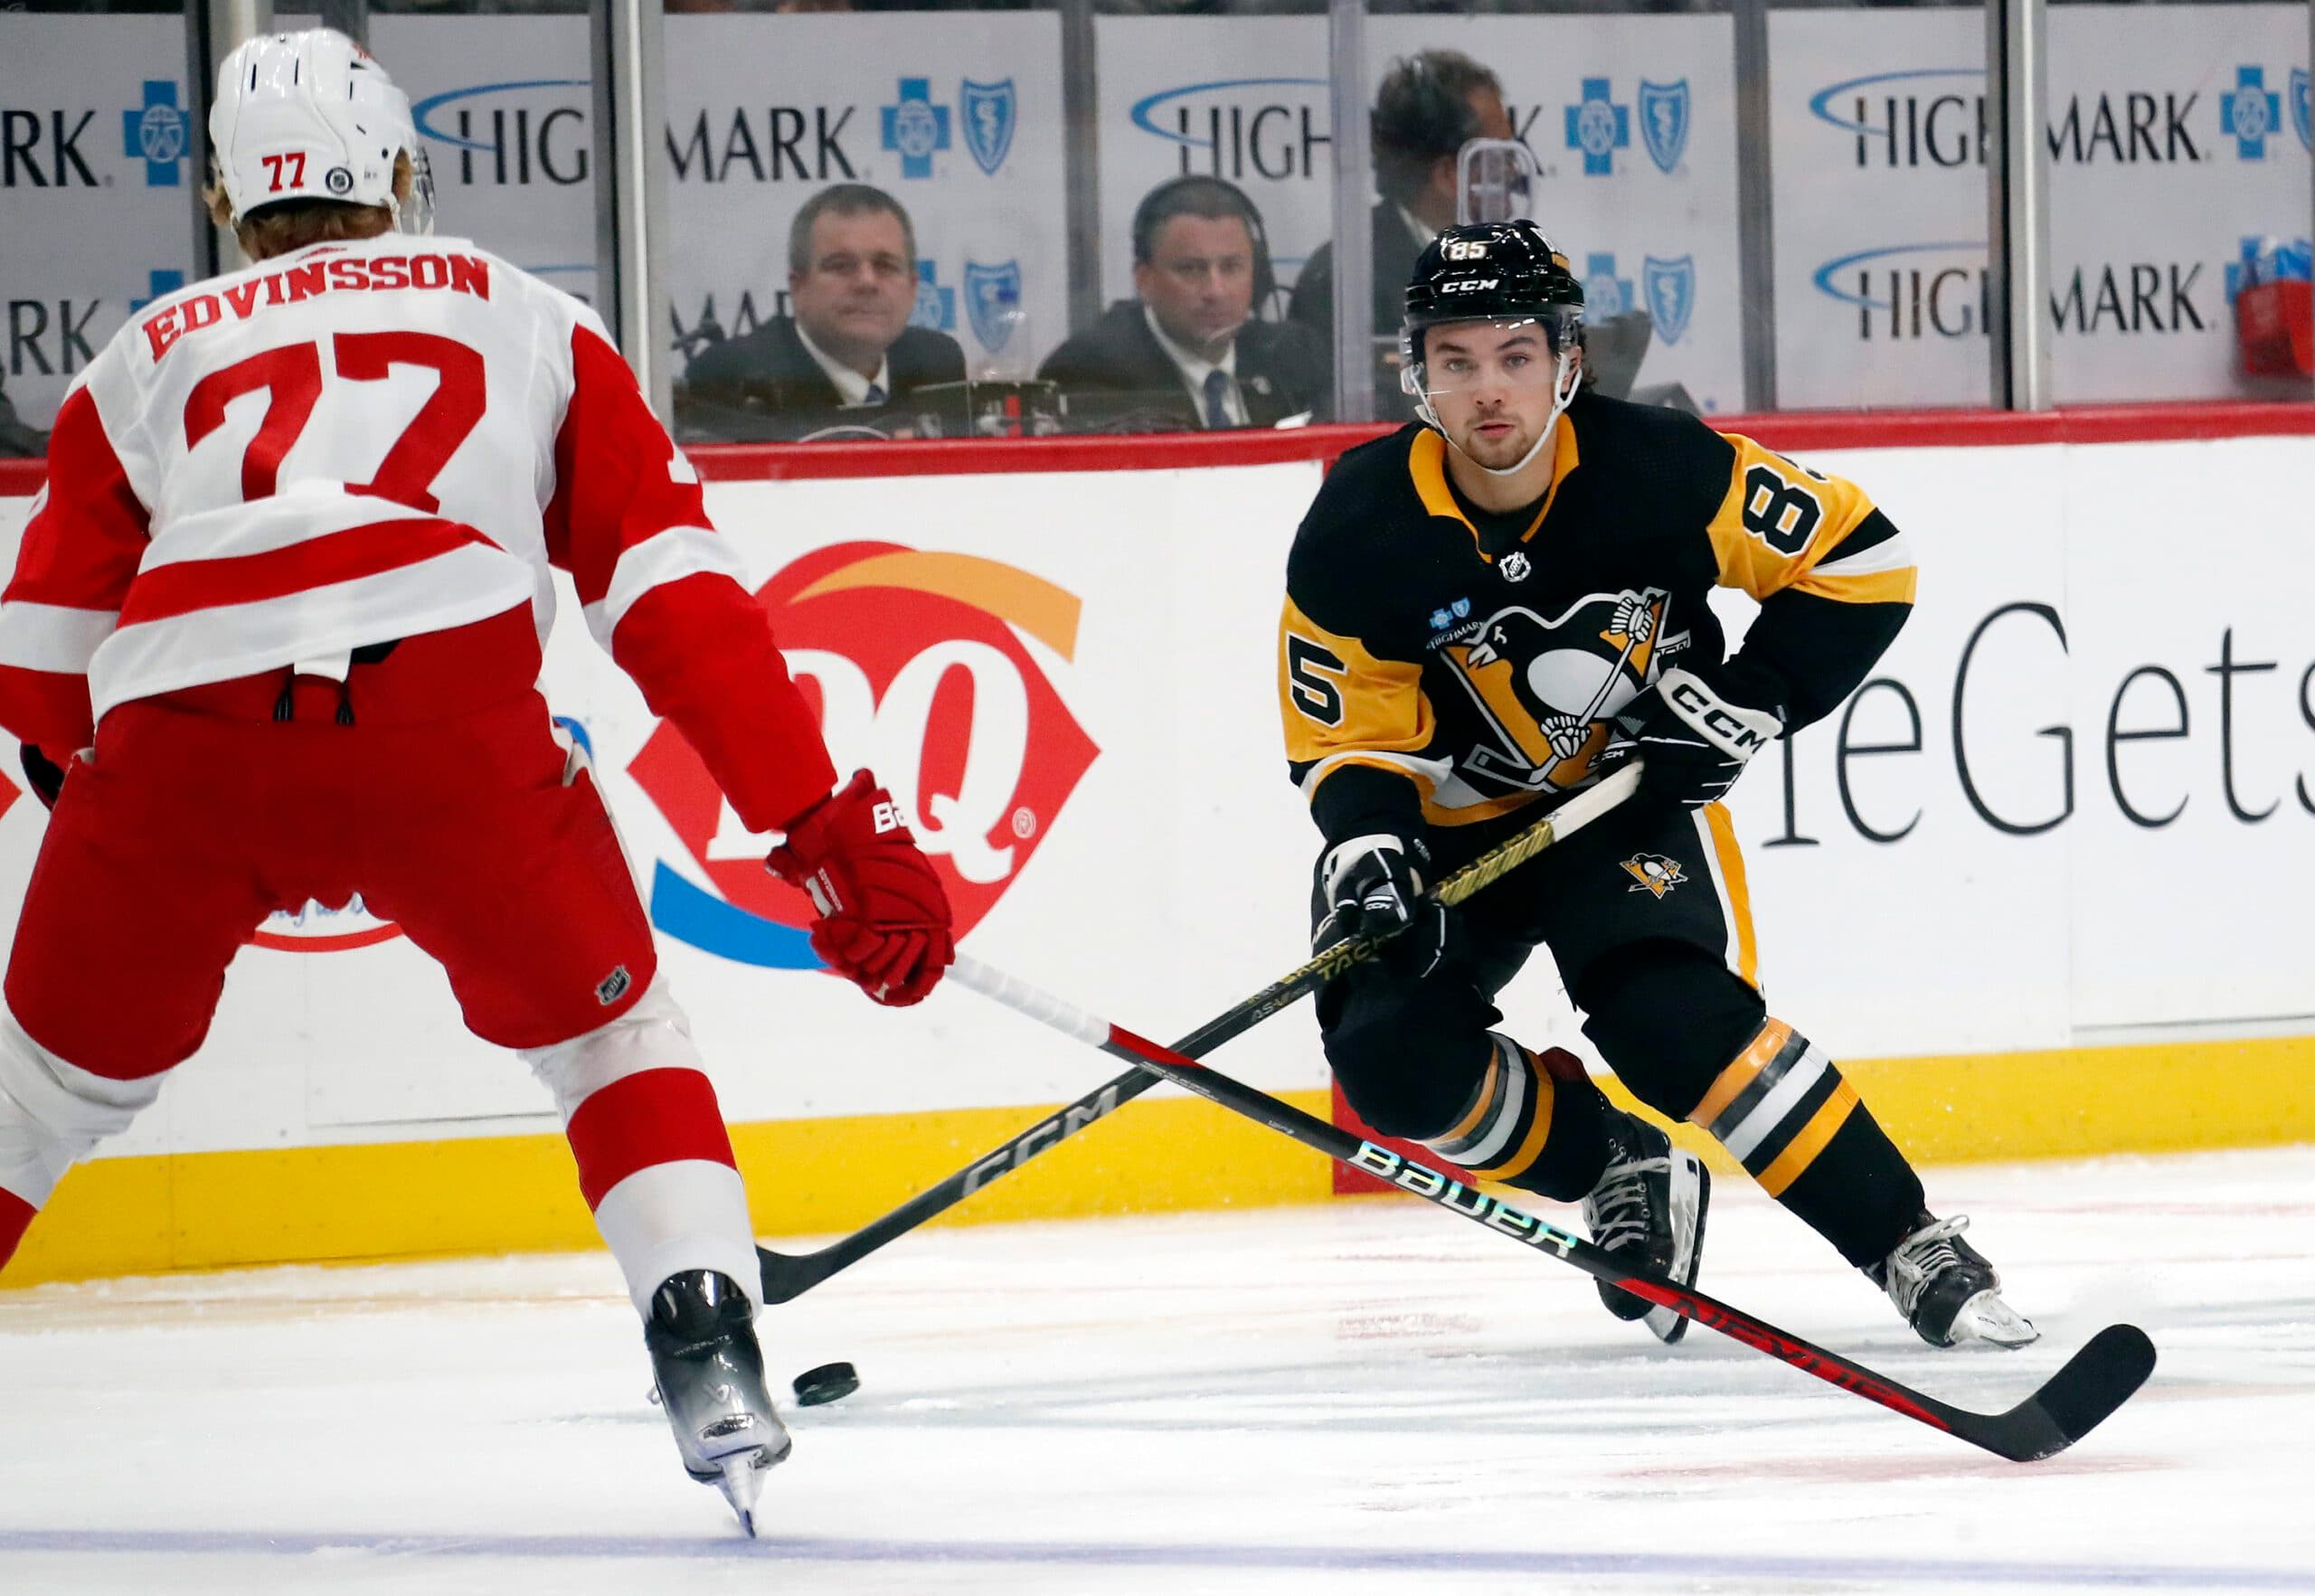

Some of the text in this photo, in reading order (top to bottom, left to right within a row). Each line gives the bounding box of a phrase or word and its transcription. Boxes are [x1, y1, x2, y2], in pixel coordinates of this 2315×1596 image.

[261, 151, 306, 193] 77
[1441, 279, 1499, 294] CCM
[1450, 241, 1488, 260] 85
[142, 254, 489, 364] EDVINSSON
[184, 331, 487, 515] 77
[1743, 452, 1830, 558] 8
[1287, 630, 1349, 729] 5
[1671, 683, 1765, 755] CCM
[961, 1084, 1120, 1196] CCM
